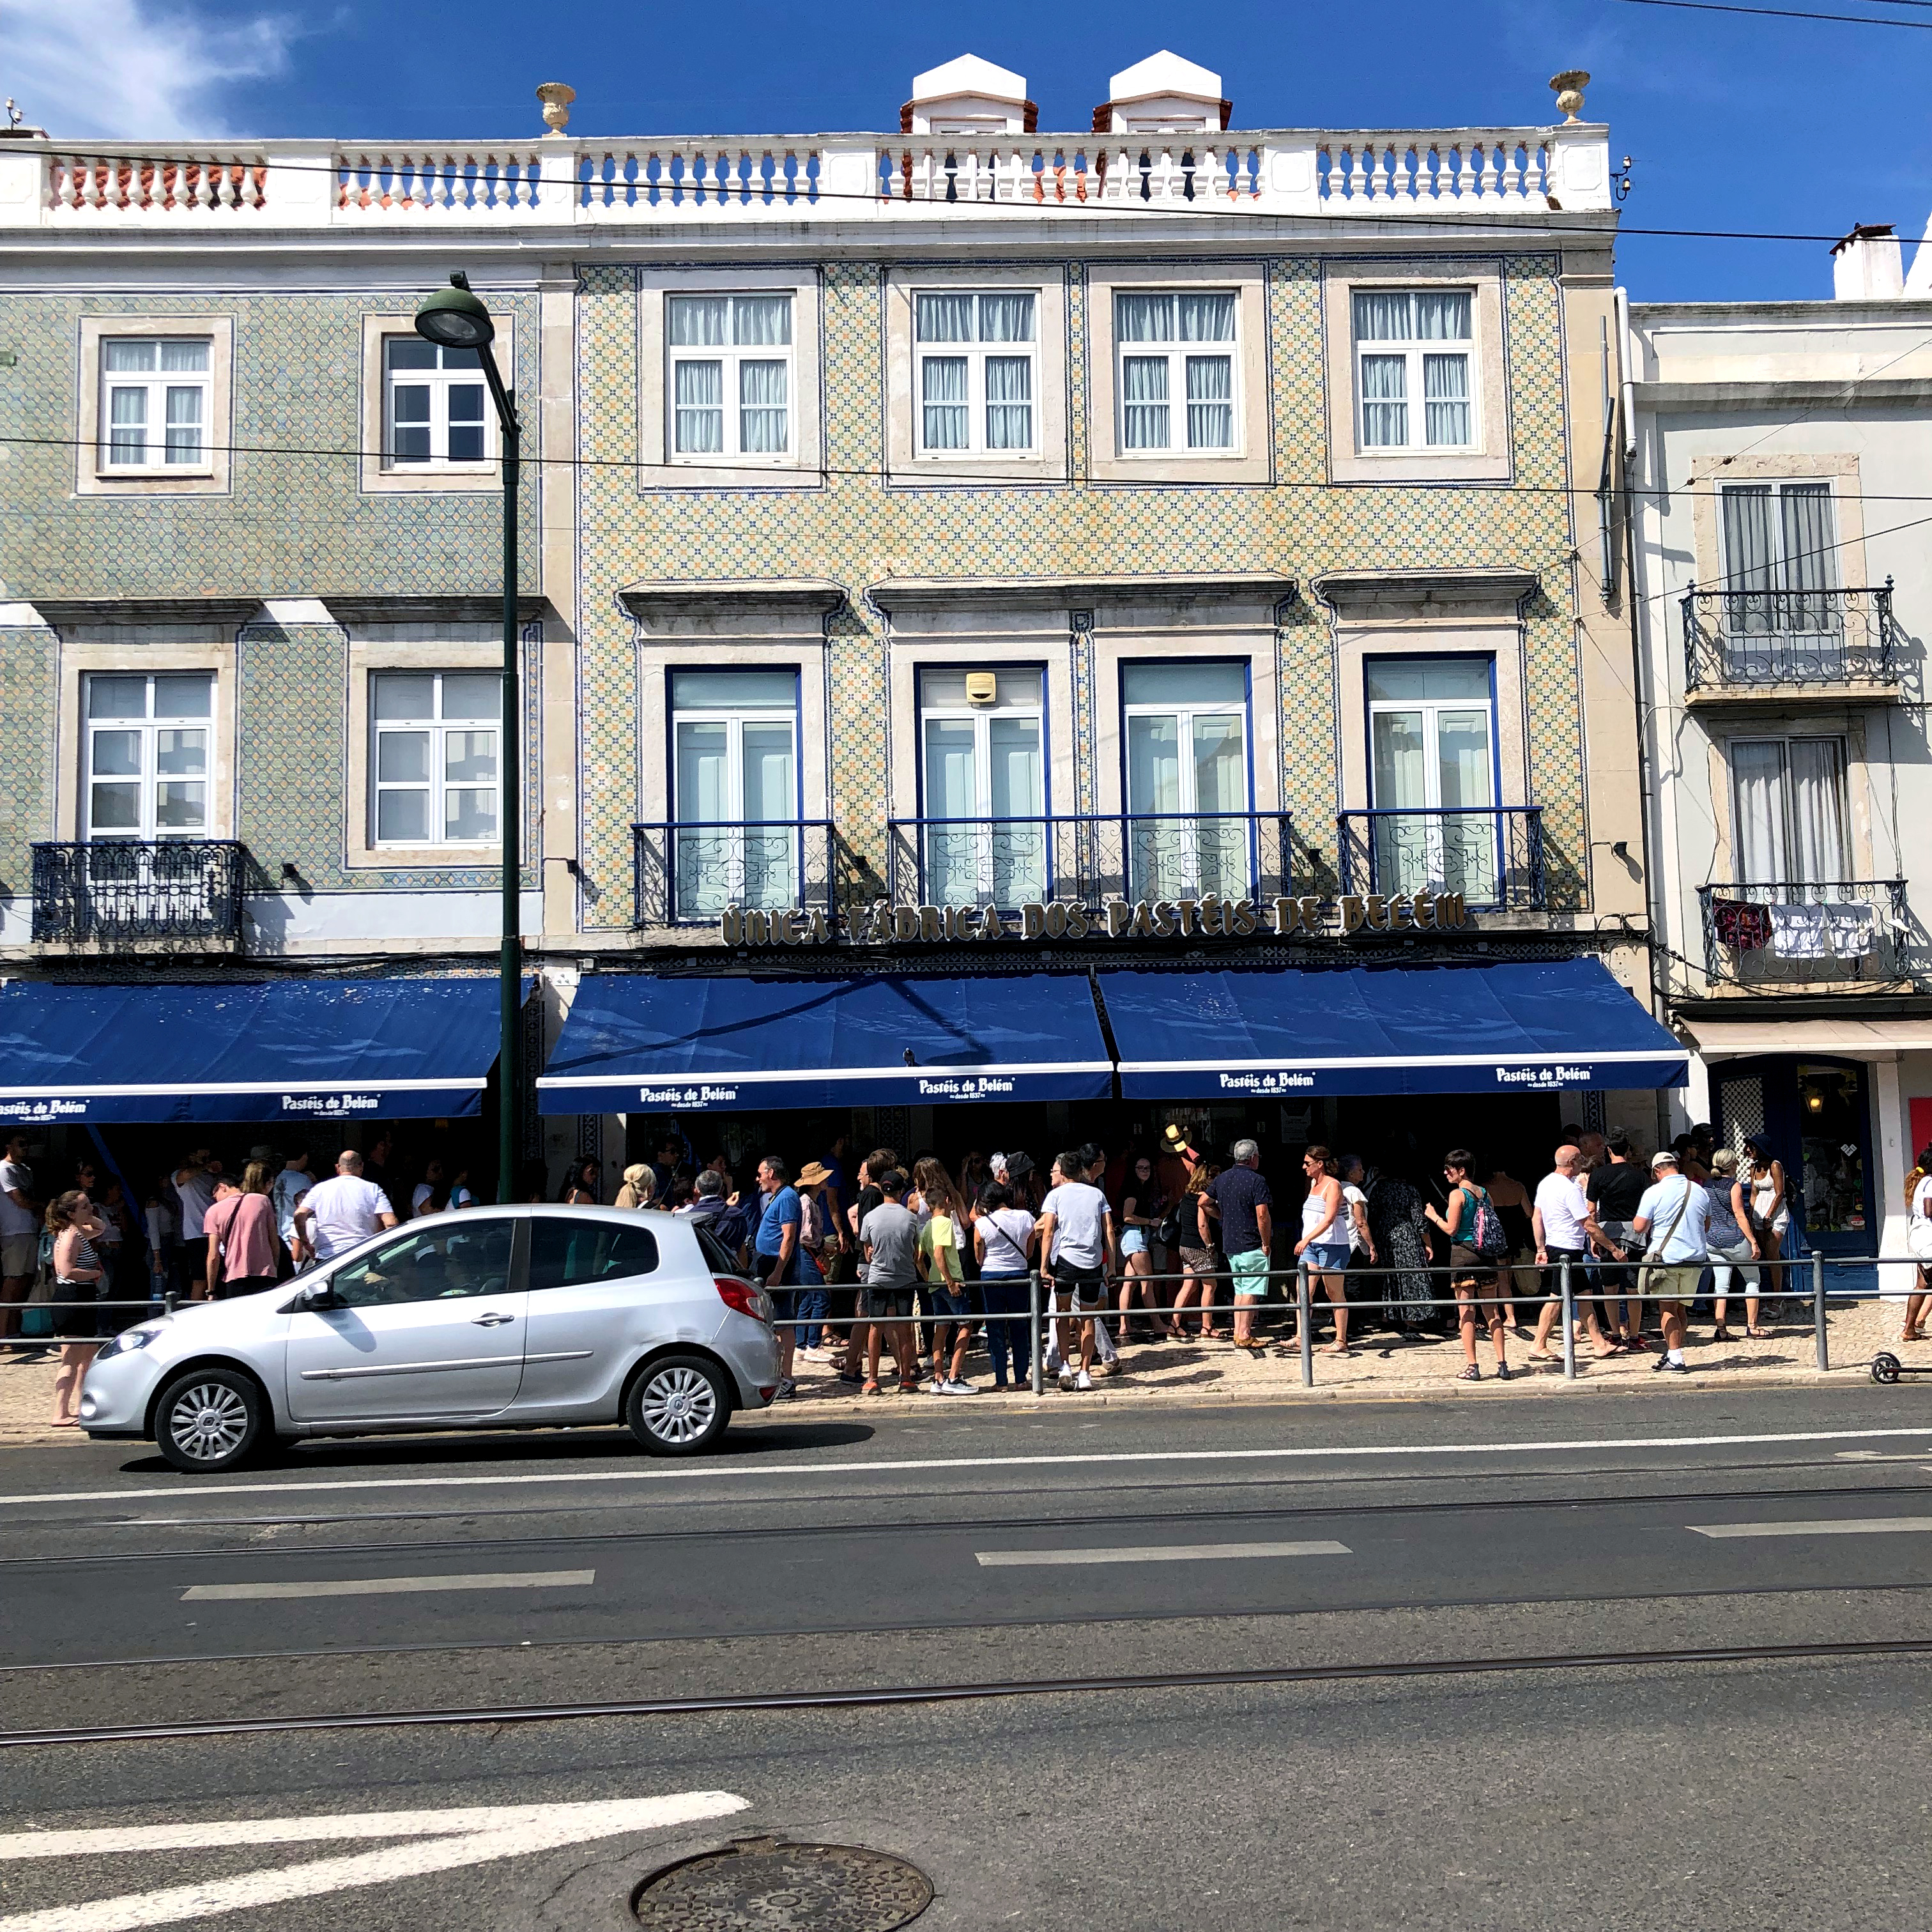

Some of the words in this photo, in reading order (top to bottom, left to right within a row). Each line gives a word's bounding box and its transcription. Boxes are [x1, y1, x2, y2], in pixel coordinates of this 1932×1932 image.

[847, 899, 1004, 942] FÁBRICA
[1020, 901, 1089, 940] DOS
[1105, 892, 1257, 938] PASTÉIS
[1272, 896, 1322, 935] DE
[1337, 886, 1466, 934] BELÉM
[1219, 1073, 1261, 1088] Pastéis
[1262, 1074, 1276, 1087] de
[1278, 1072, 1314, 1087] Belém
[1496, 1067, 1537, 1082] Pastéis
[1539, 1068, 1553, 1081] de
[1555, 1066, 1591, 1080] Belém
[640, 1087, 682, 1102] Pastéis
[684, 1088, 698, 1101] de
[700, 1086, 736, 1100] Belém
[919, 1079, 960, 1094] Pastéis
[962, 1080, 976, 1092] de
[978, 1078, 1013, 1092] Belém
[33, 1101, 48, 1114] de
[49, 1100, 86, 1114] Belém
[282, 1095, 324, 1110] Pastéis
[325, 1096, 340, 1109] de
[341, 1094, 378, 1109] Belém
